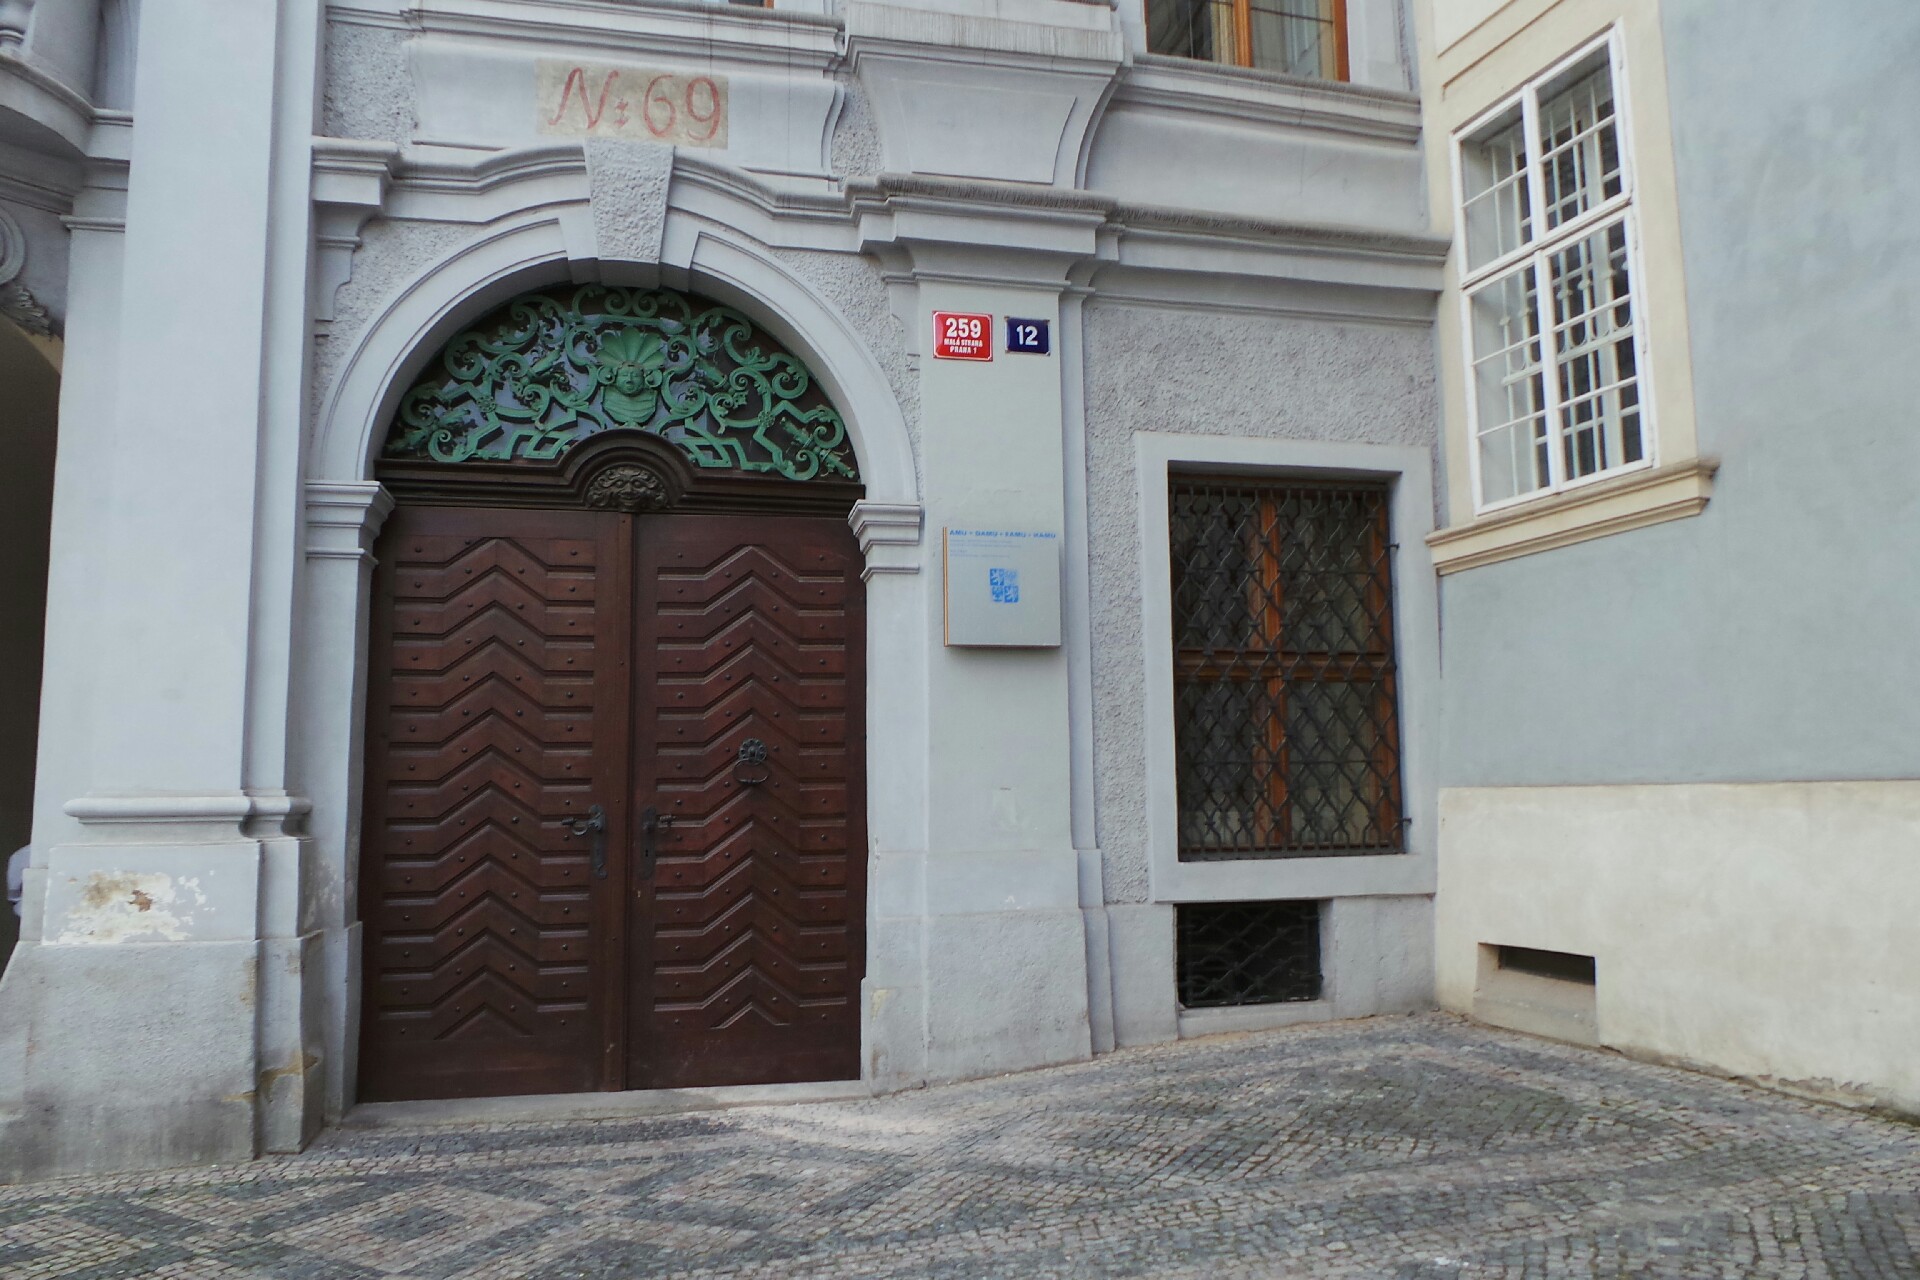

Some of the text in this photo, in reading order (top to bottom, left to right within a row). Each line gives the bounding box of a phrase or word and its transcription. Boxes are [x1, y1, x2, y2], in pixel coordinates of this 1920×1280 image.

[643, 74, 721, 141] 69
[945, 318, 982, 338] 259
[1016, 325, 1038, 346] 12
[944, 337, 983, 347] MALÁ STRANA
[949, 346, 972, 354] PRAHA
